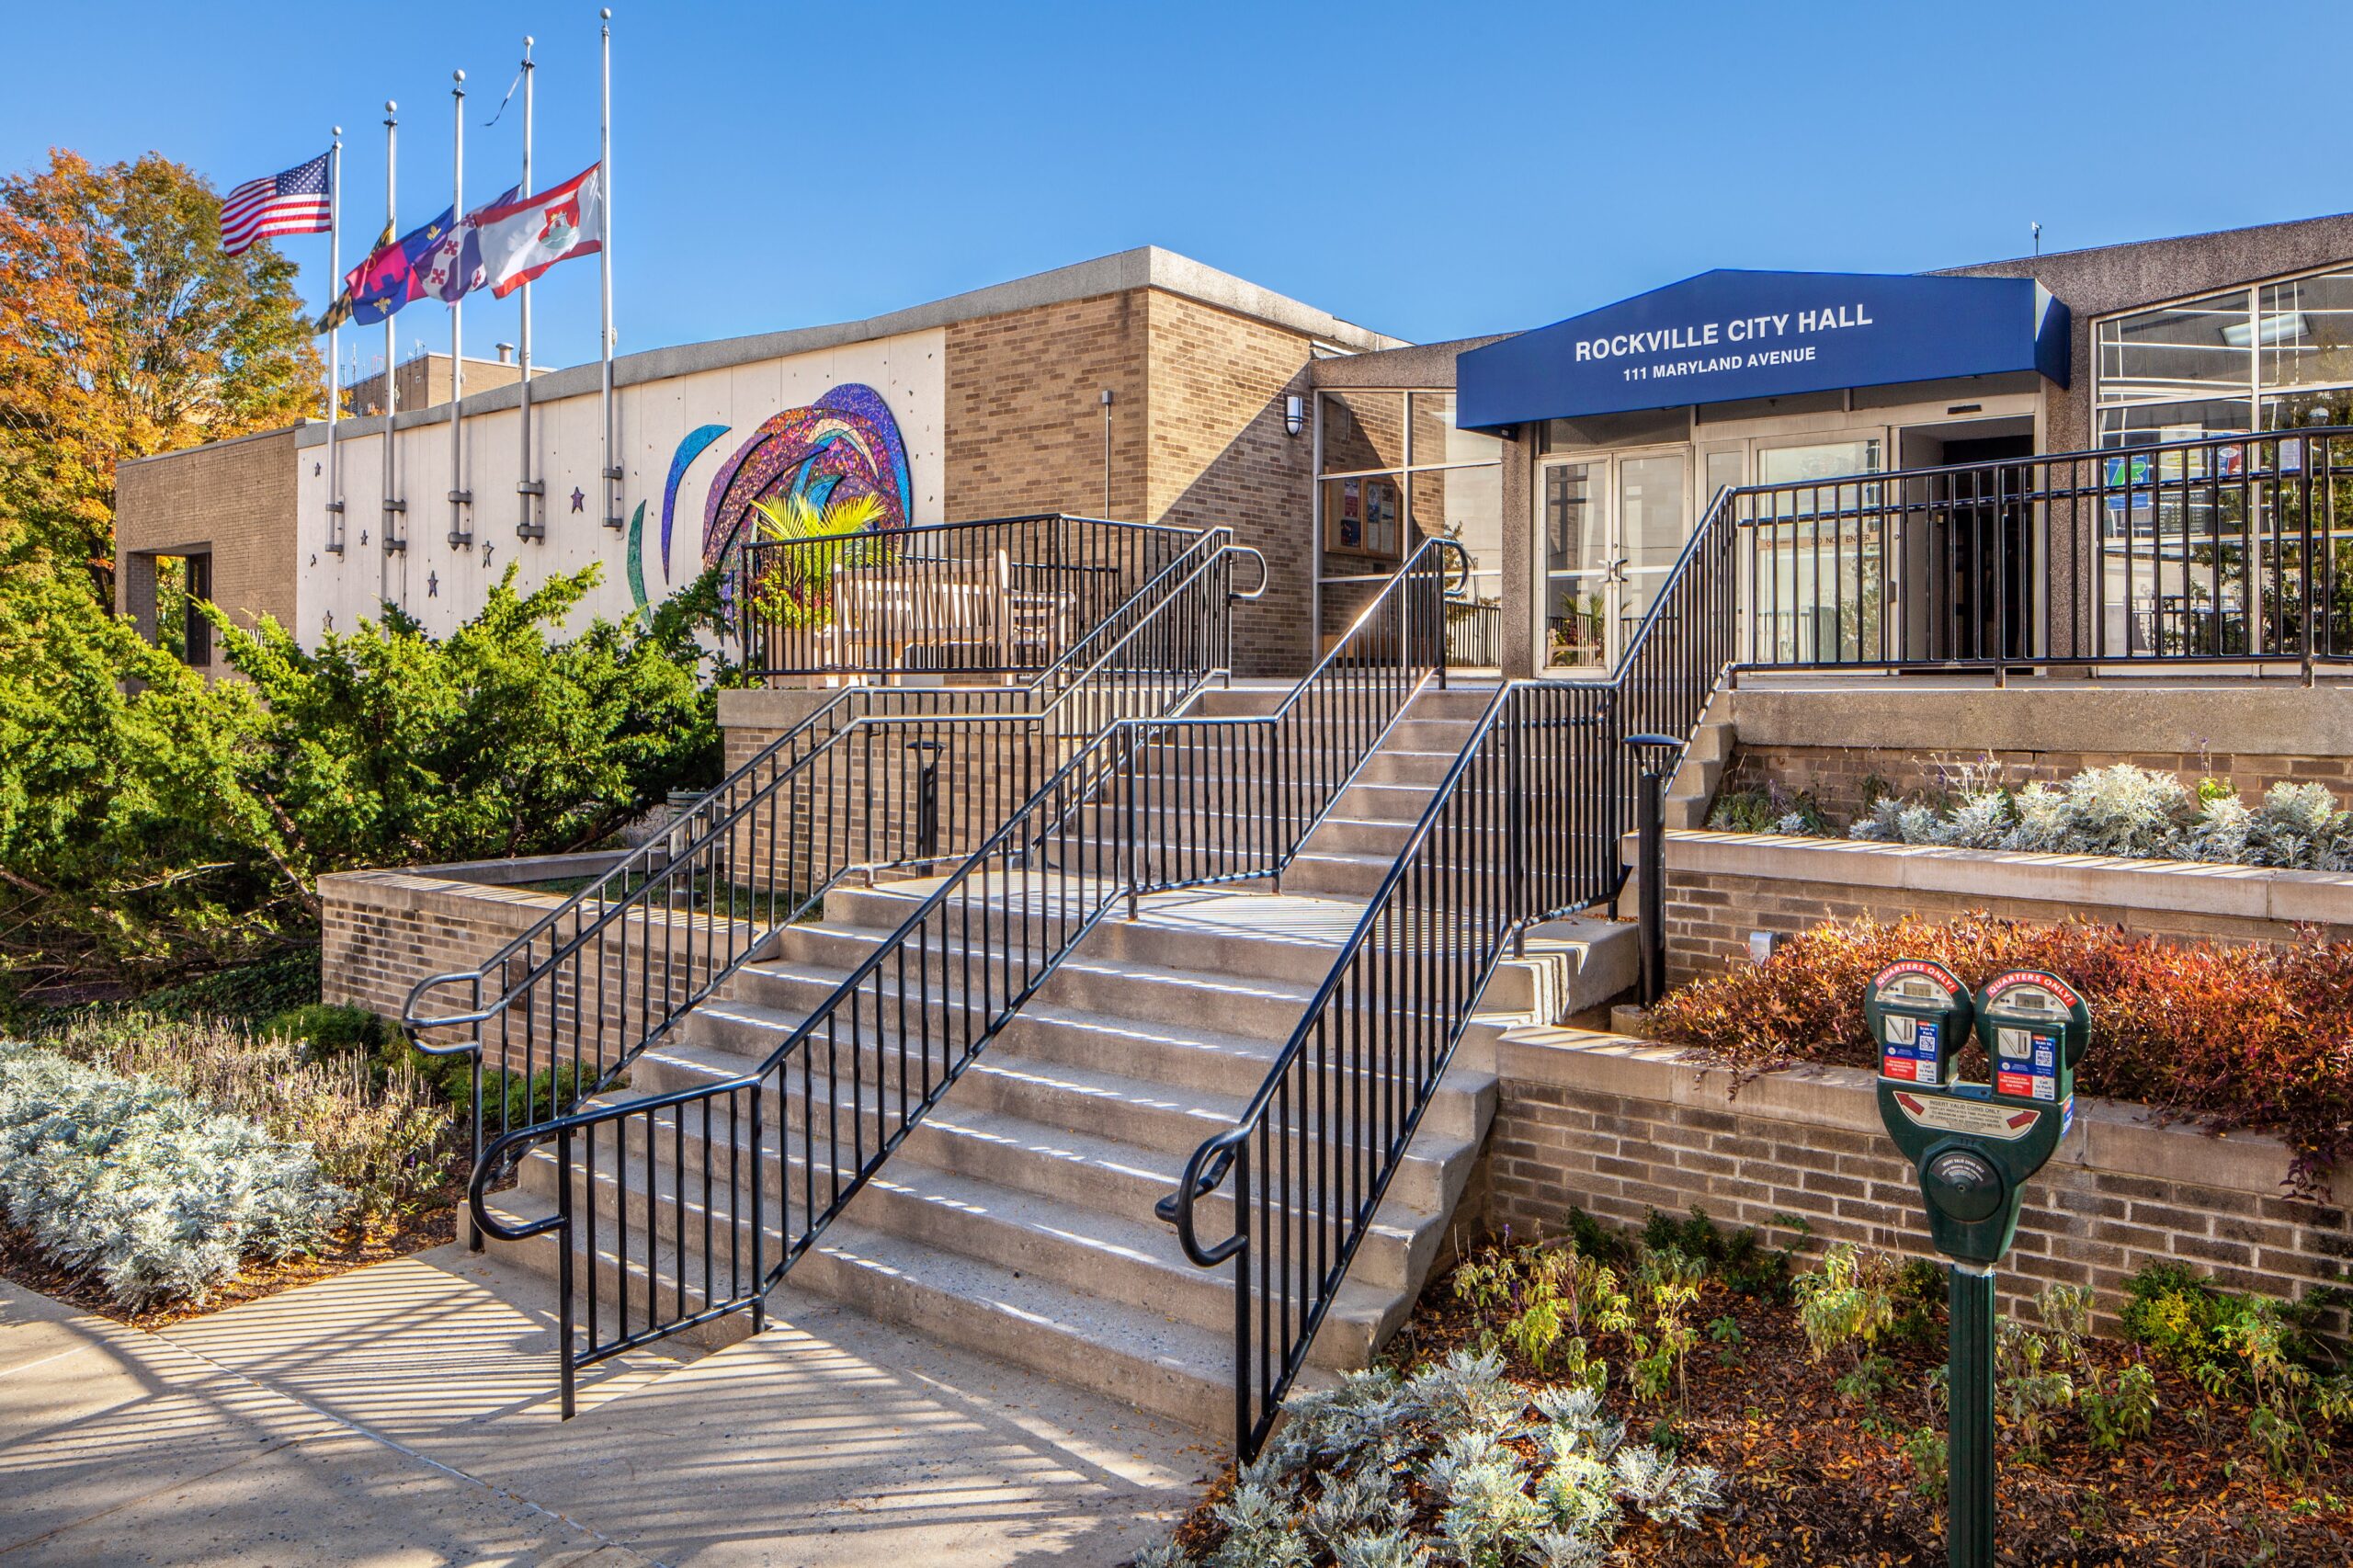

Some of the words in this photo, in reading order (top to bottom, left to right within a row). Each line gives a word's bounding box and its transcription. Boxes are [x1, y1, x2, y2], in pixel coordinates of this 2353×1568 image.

[1575, 323, 1719, 362] ROCKVILLE
[1727, 313, 1790, 343] CITY
[1798, 303, 1873, 334] HALL
[1622, 367, 1647, 382] 111
[1653, 356, 1744, 380] MARYLAND
[1746, 347, 1816, 368] AVENUE
[1877, 963, 1925, 983] QUARTERS
[1927, 967, 1955, 990] ONLY!
[1989, 973, 2040, 994] QUARTERS
[2043, 978, 2074, 1003] ONLY!
